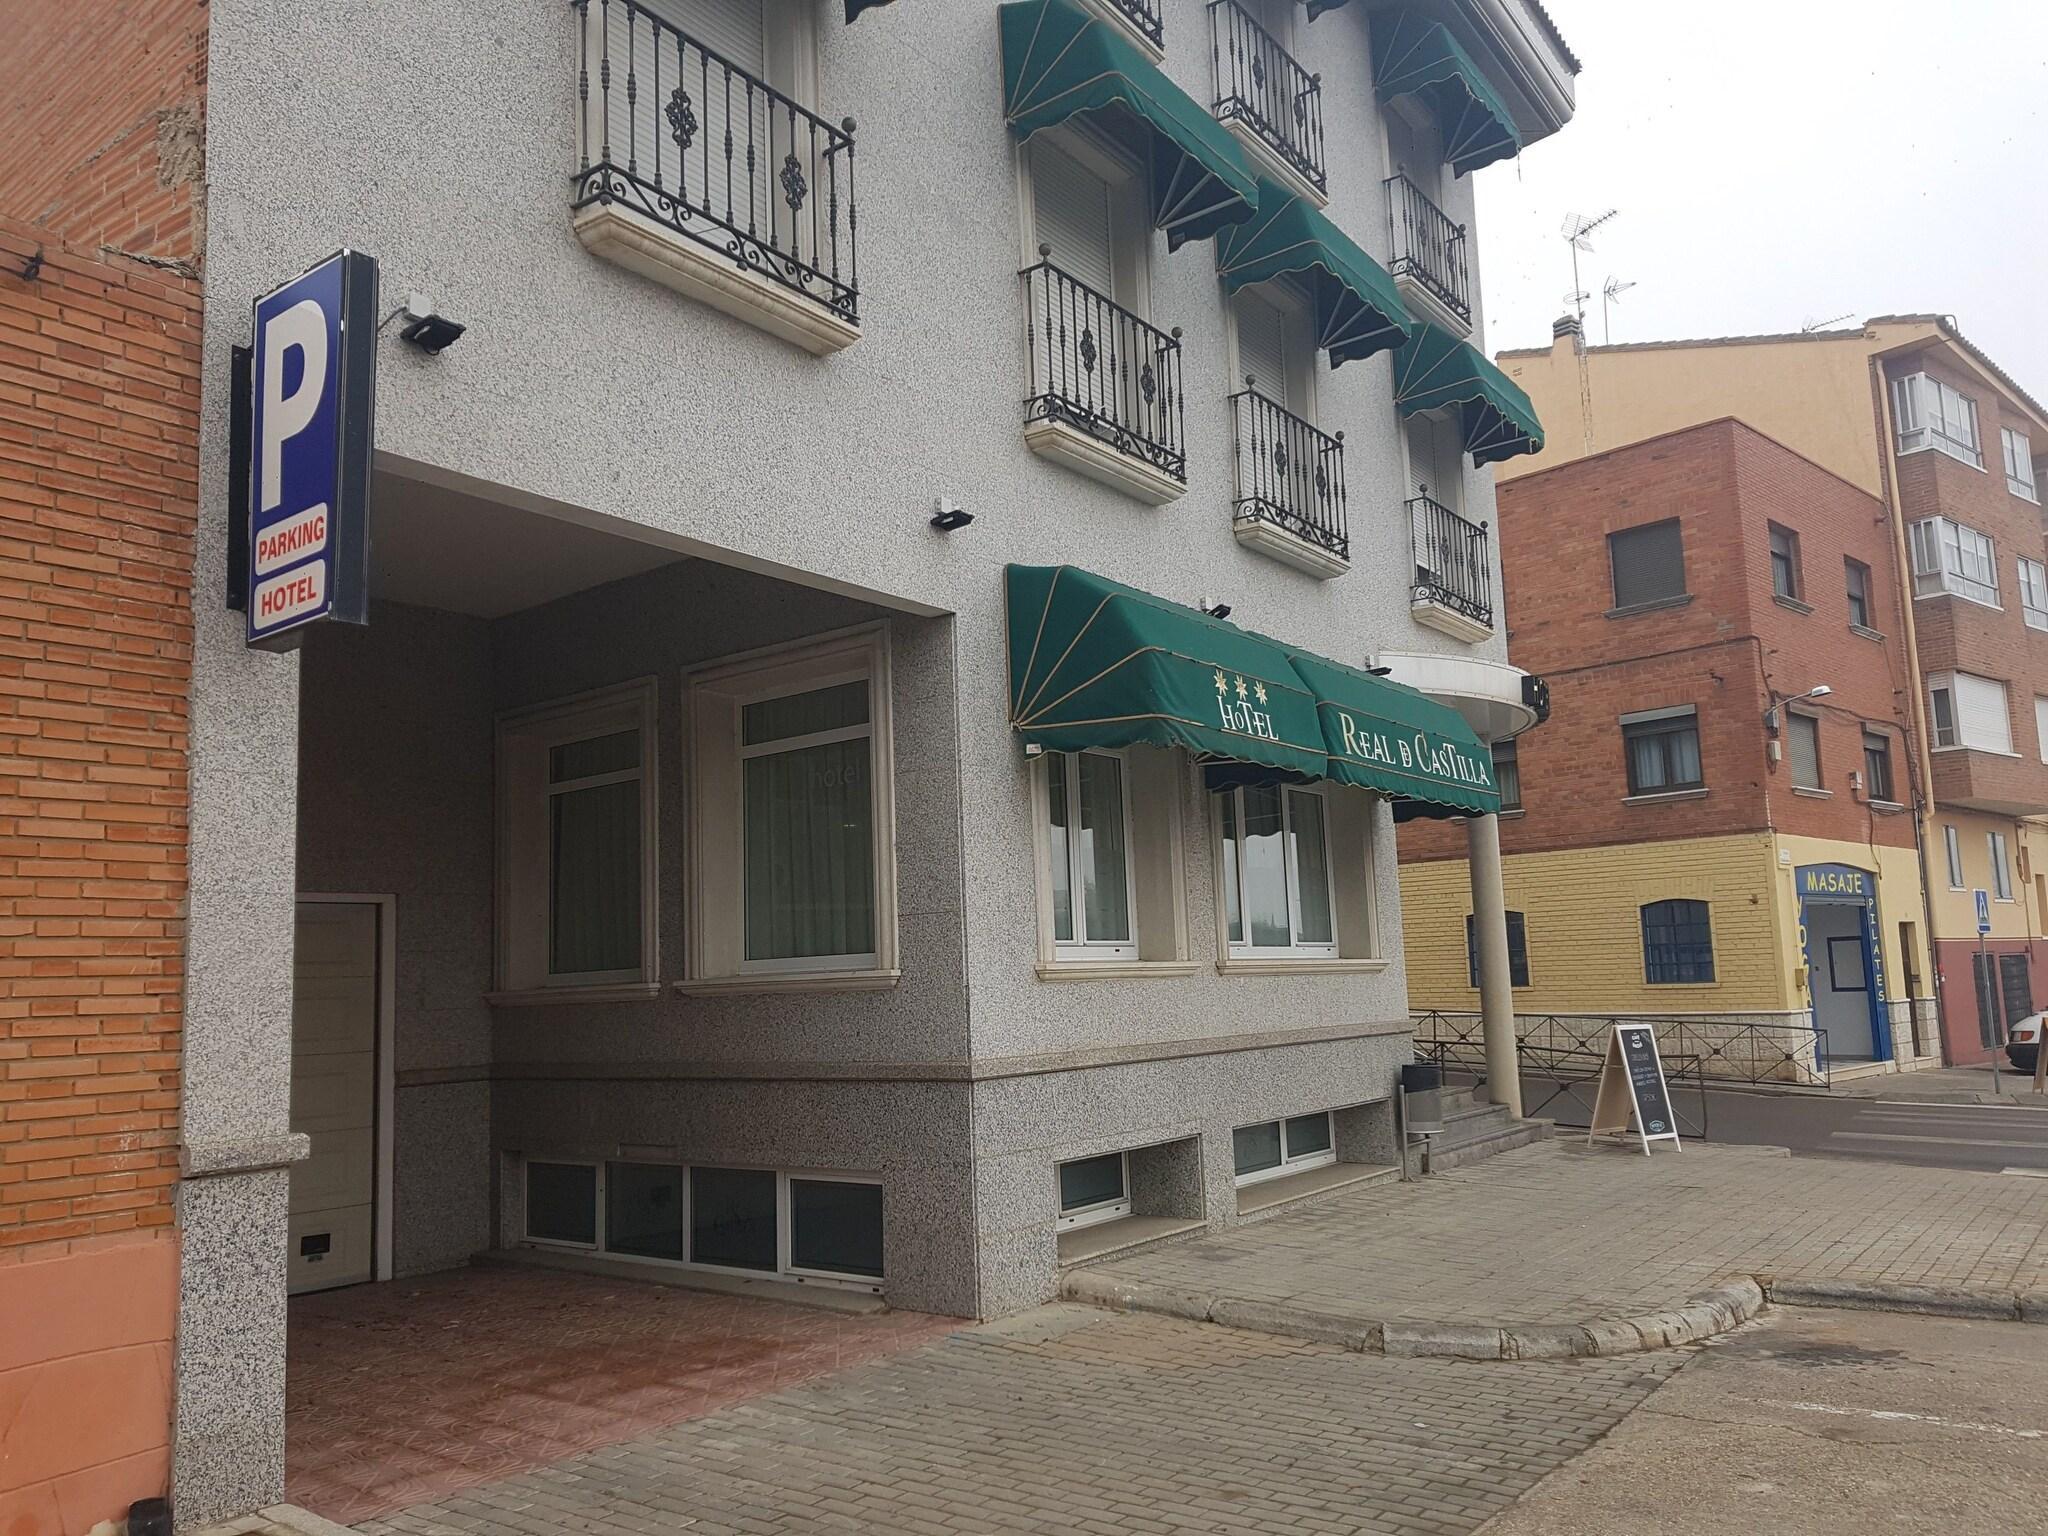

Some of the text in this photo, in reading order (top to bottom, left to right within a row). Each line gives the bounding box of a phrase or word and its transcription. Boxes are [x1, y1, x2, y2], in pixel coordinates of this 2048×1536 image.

[261, 299, 328, 513] P
[258, 516, 325, 564] PARKING
[260, 576, 317, 617] HOTEL
[1338, 711, 1397, 765] REAL
[1414, 731, 1491, 786] CASTILLA
[1807, 872, 1862, 894] MASAJE
[1868, 898, 1885, 1002] PILATES
